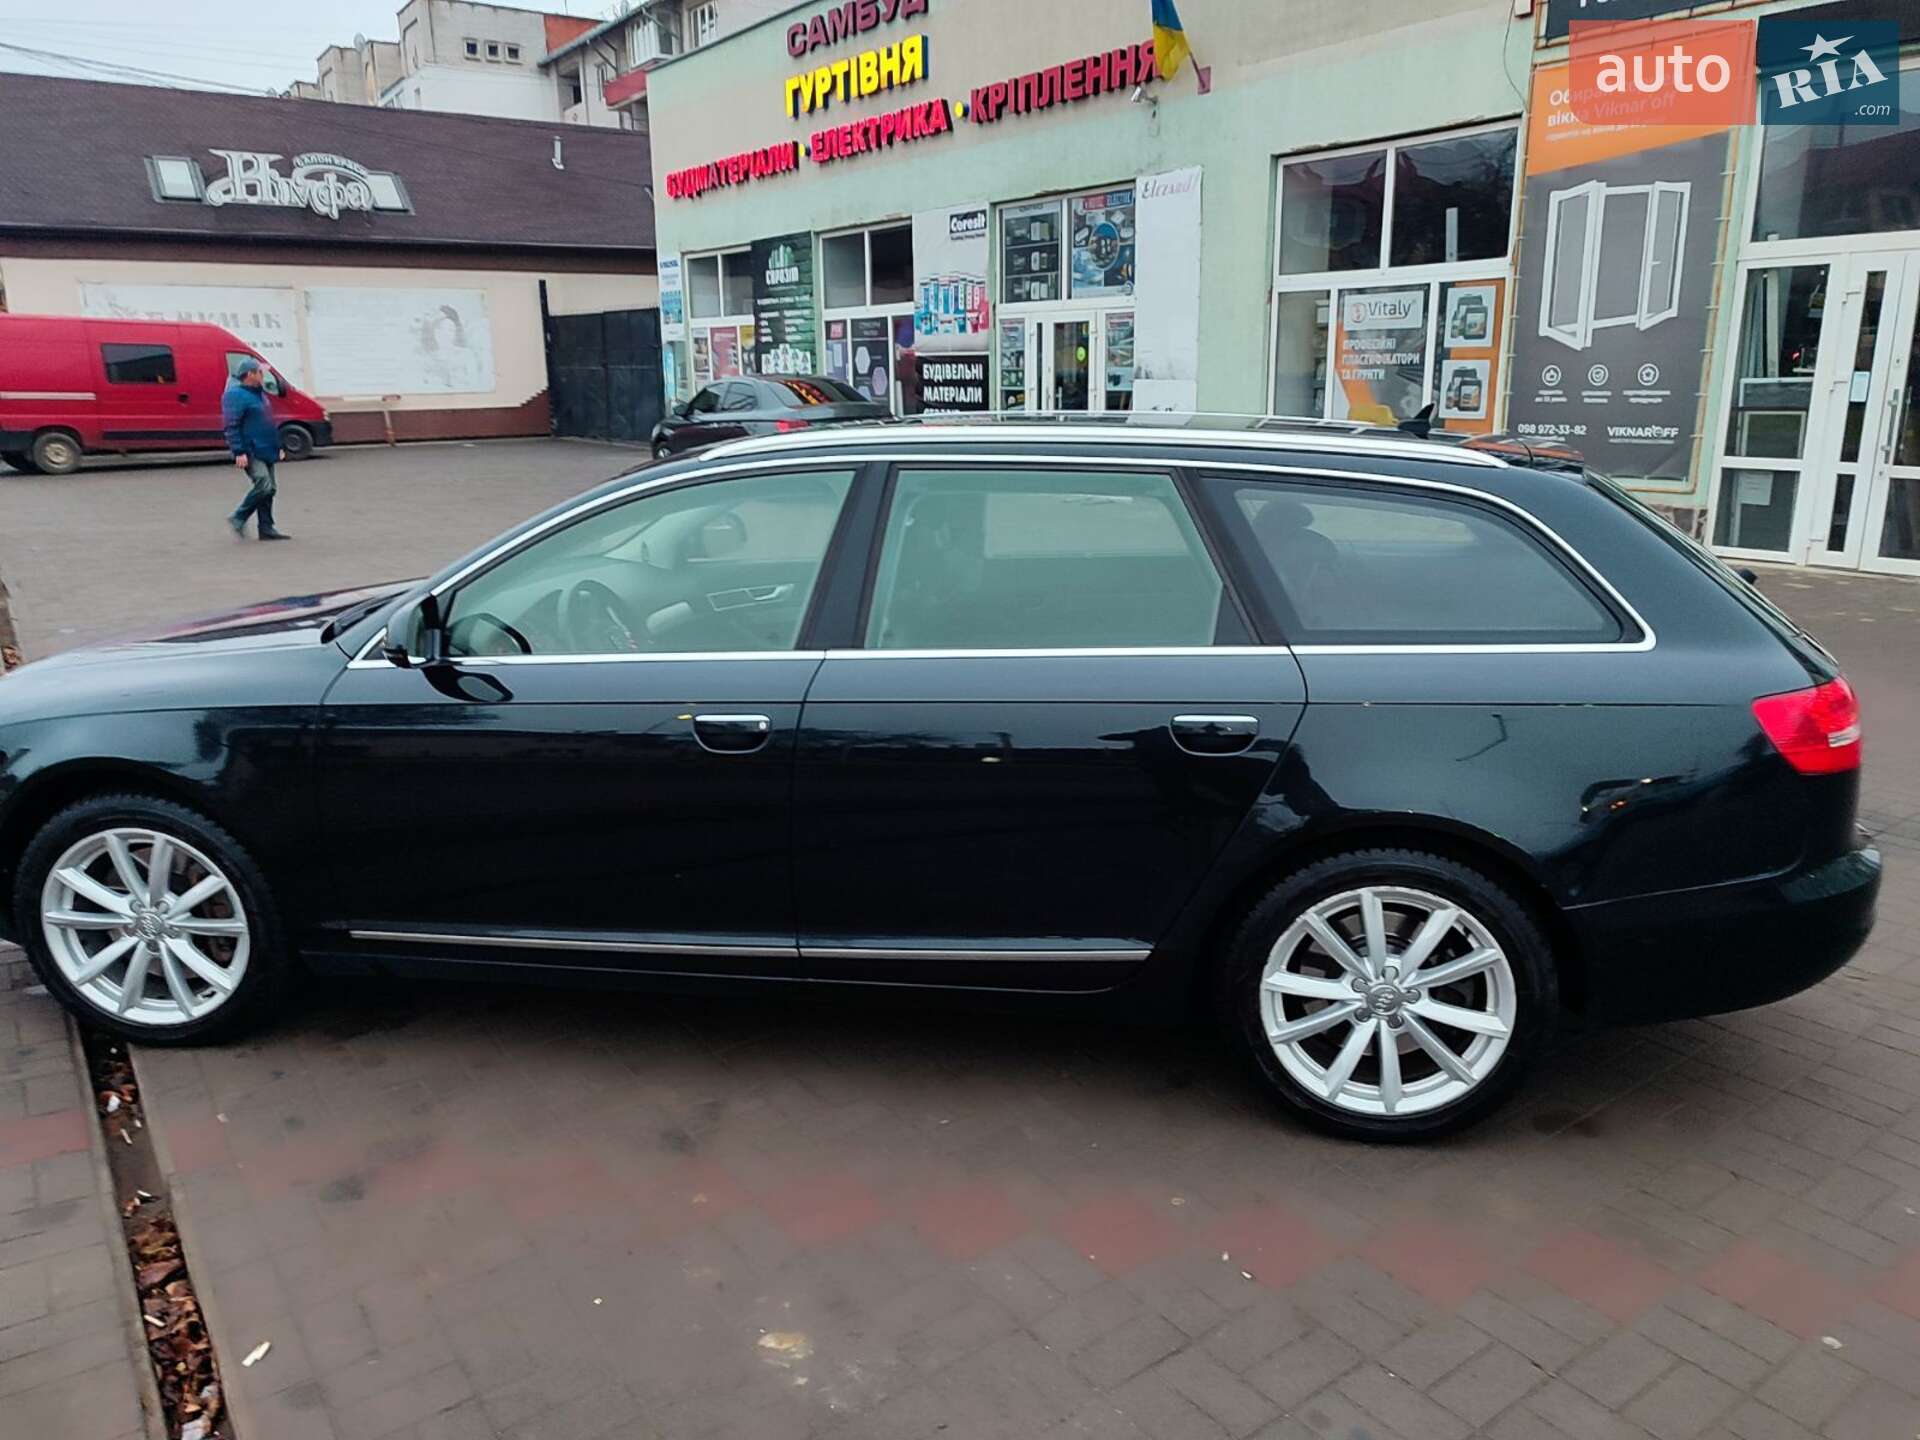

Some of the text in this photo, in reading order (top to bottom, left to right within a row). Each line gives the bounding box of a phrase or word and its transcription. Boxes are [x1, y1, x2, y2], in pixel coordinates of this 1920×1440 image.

[785, 34, 926, 119] ГУРТІВНЯ
[810, 98, 952, 164] ЕЛЕКТРИКА
[970, 40, 1160, 123] КРІПЛЕННЯ
[950, 212, 986, 232] Ceresit
[1368, 299, 1412, 320] Vitaly
[922, 363, 984, 383] БУДІВЕЛЬНІ
[923, 386, 983, 404] МАТЕРІАЛИ
[1517, 423, 1588, 436] 098 972-33-82
